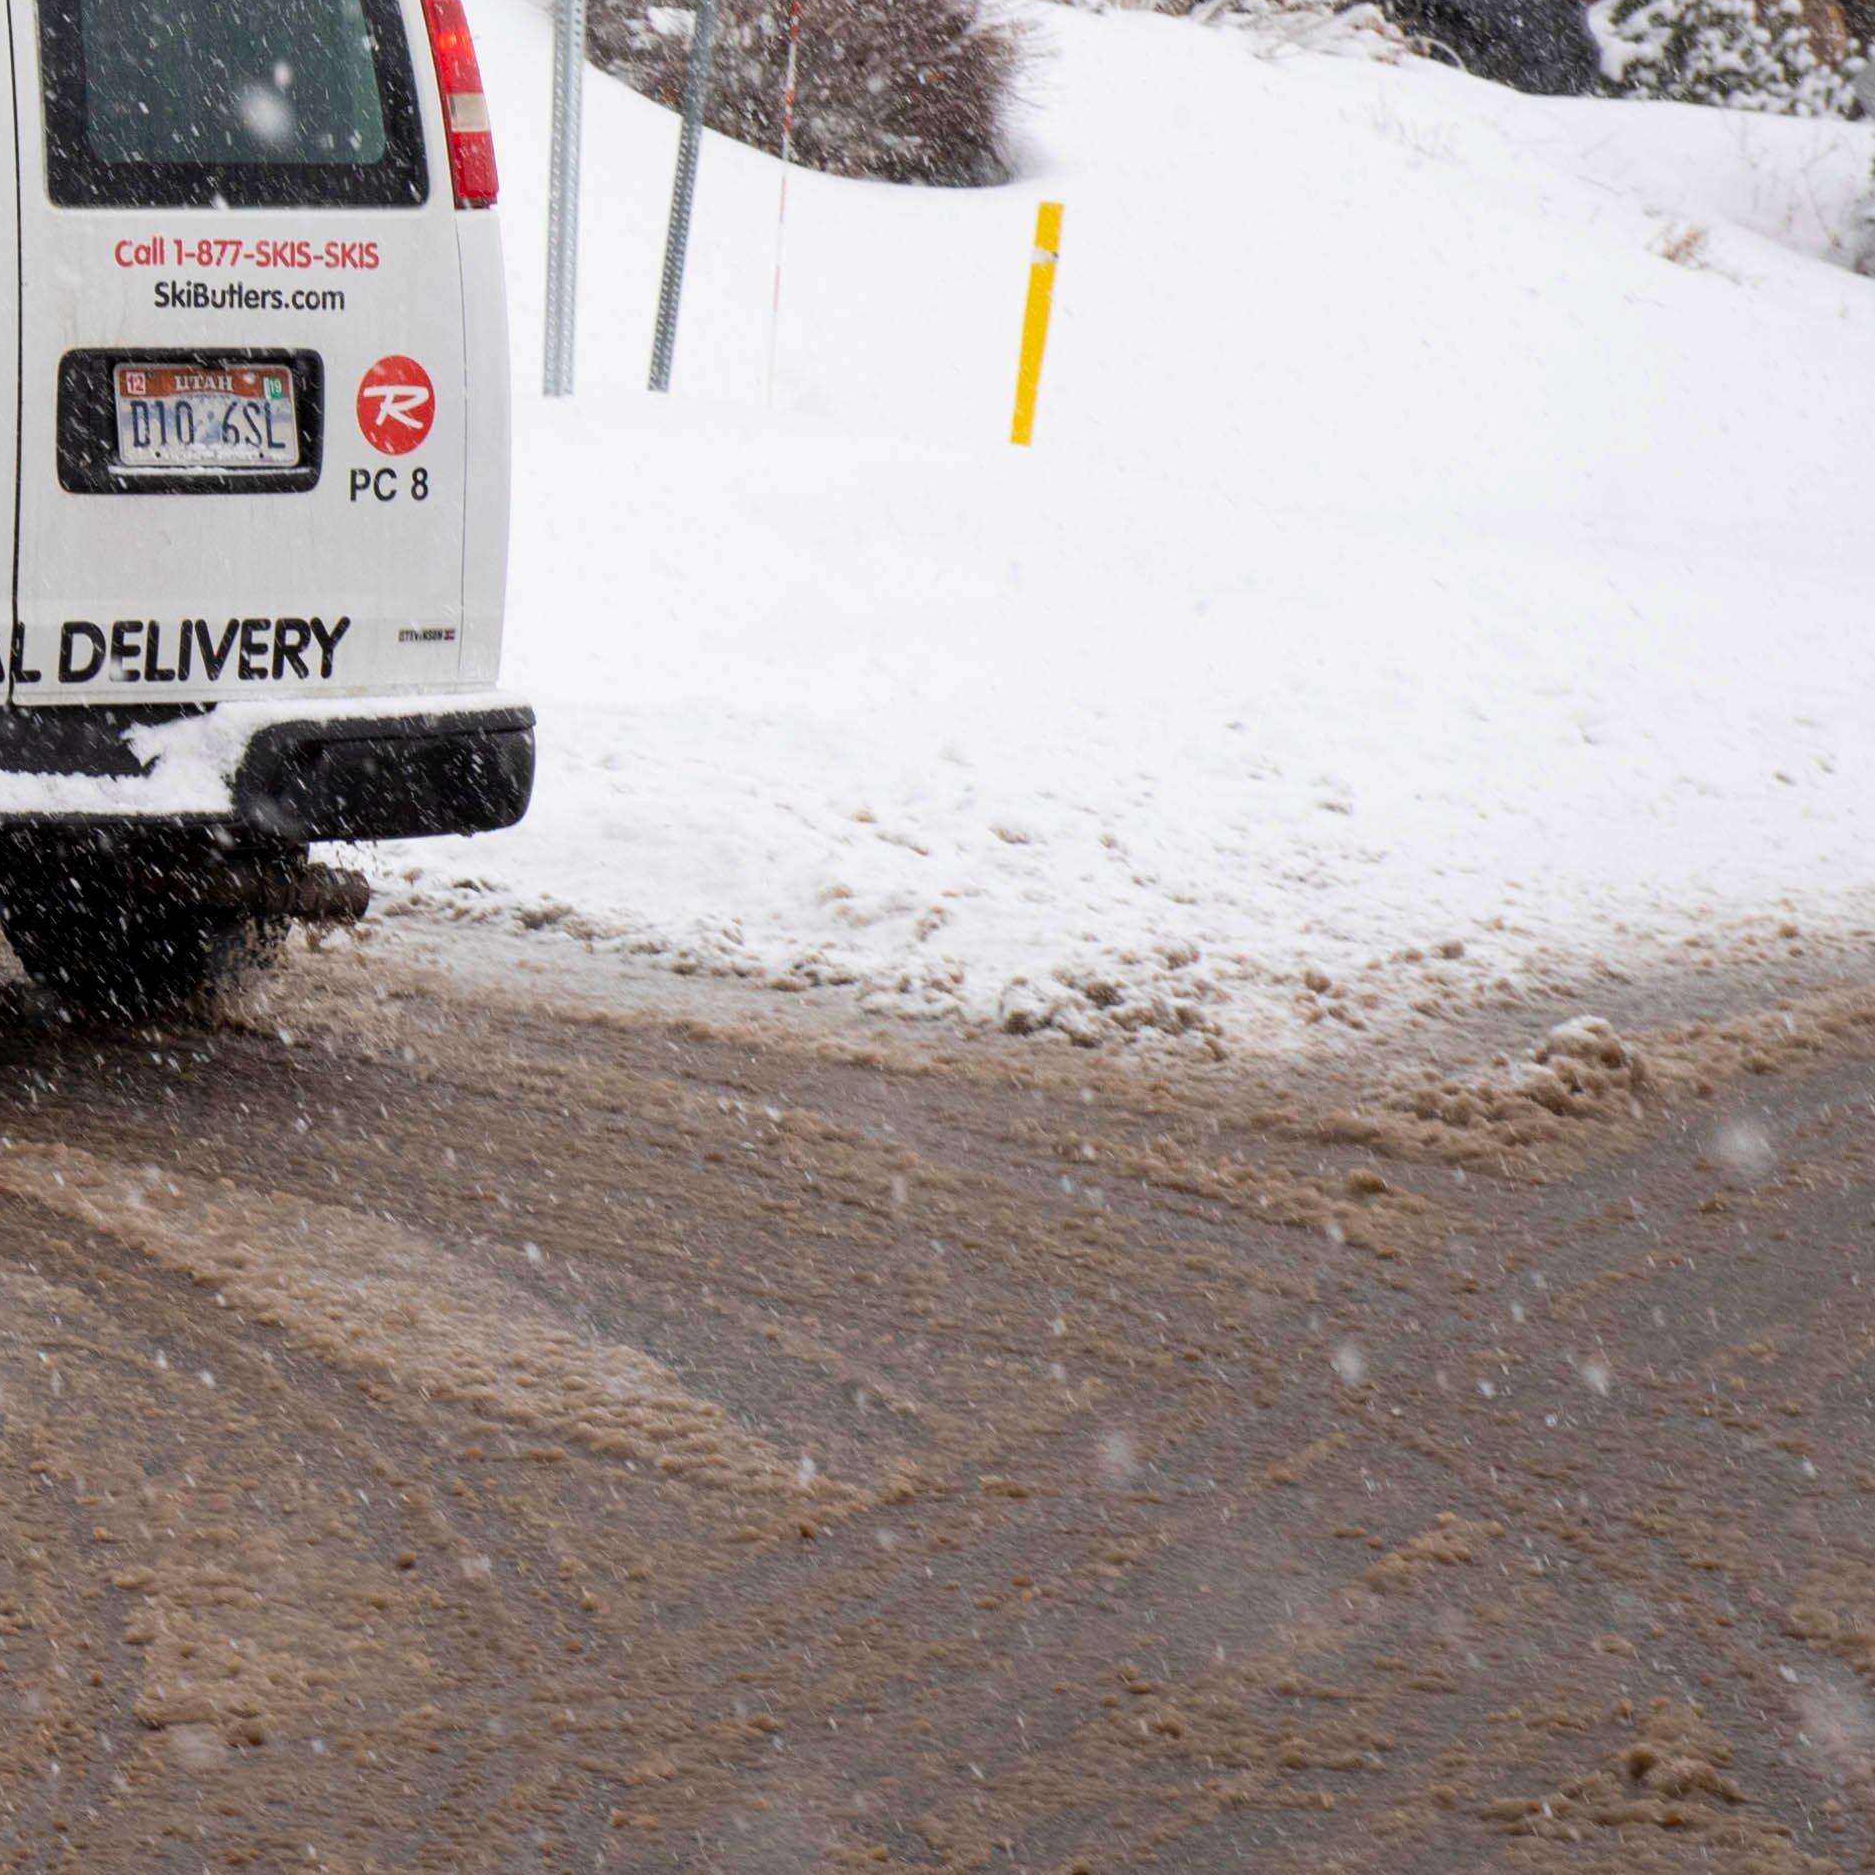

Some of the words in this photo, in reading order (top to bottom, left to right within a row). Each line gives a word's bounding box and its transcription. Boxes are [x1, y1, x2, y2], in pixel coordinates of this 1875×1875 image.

[114, 236, 165, 267] Call
[173, 237, 380, 270] 1-877-SKIS-SKIS
[153, 281, 346, 312] SkiButlers.com
[174, 374, 234, 392] UTAH
[221, 401, 286, 449] 6SL
[350, 468, 398, 502] PC
[409, 468, 430, 501] 8
[57, 616, 351, 684] DELIVERY
